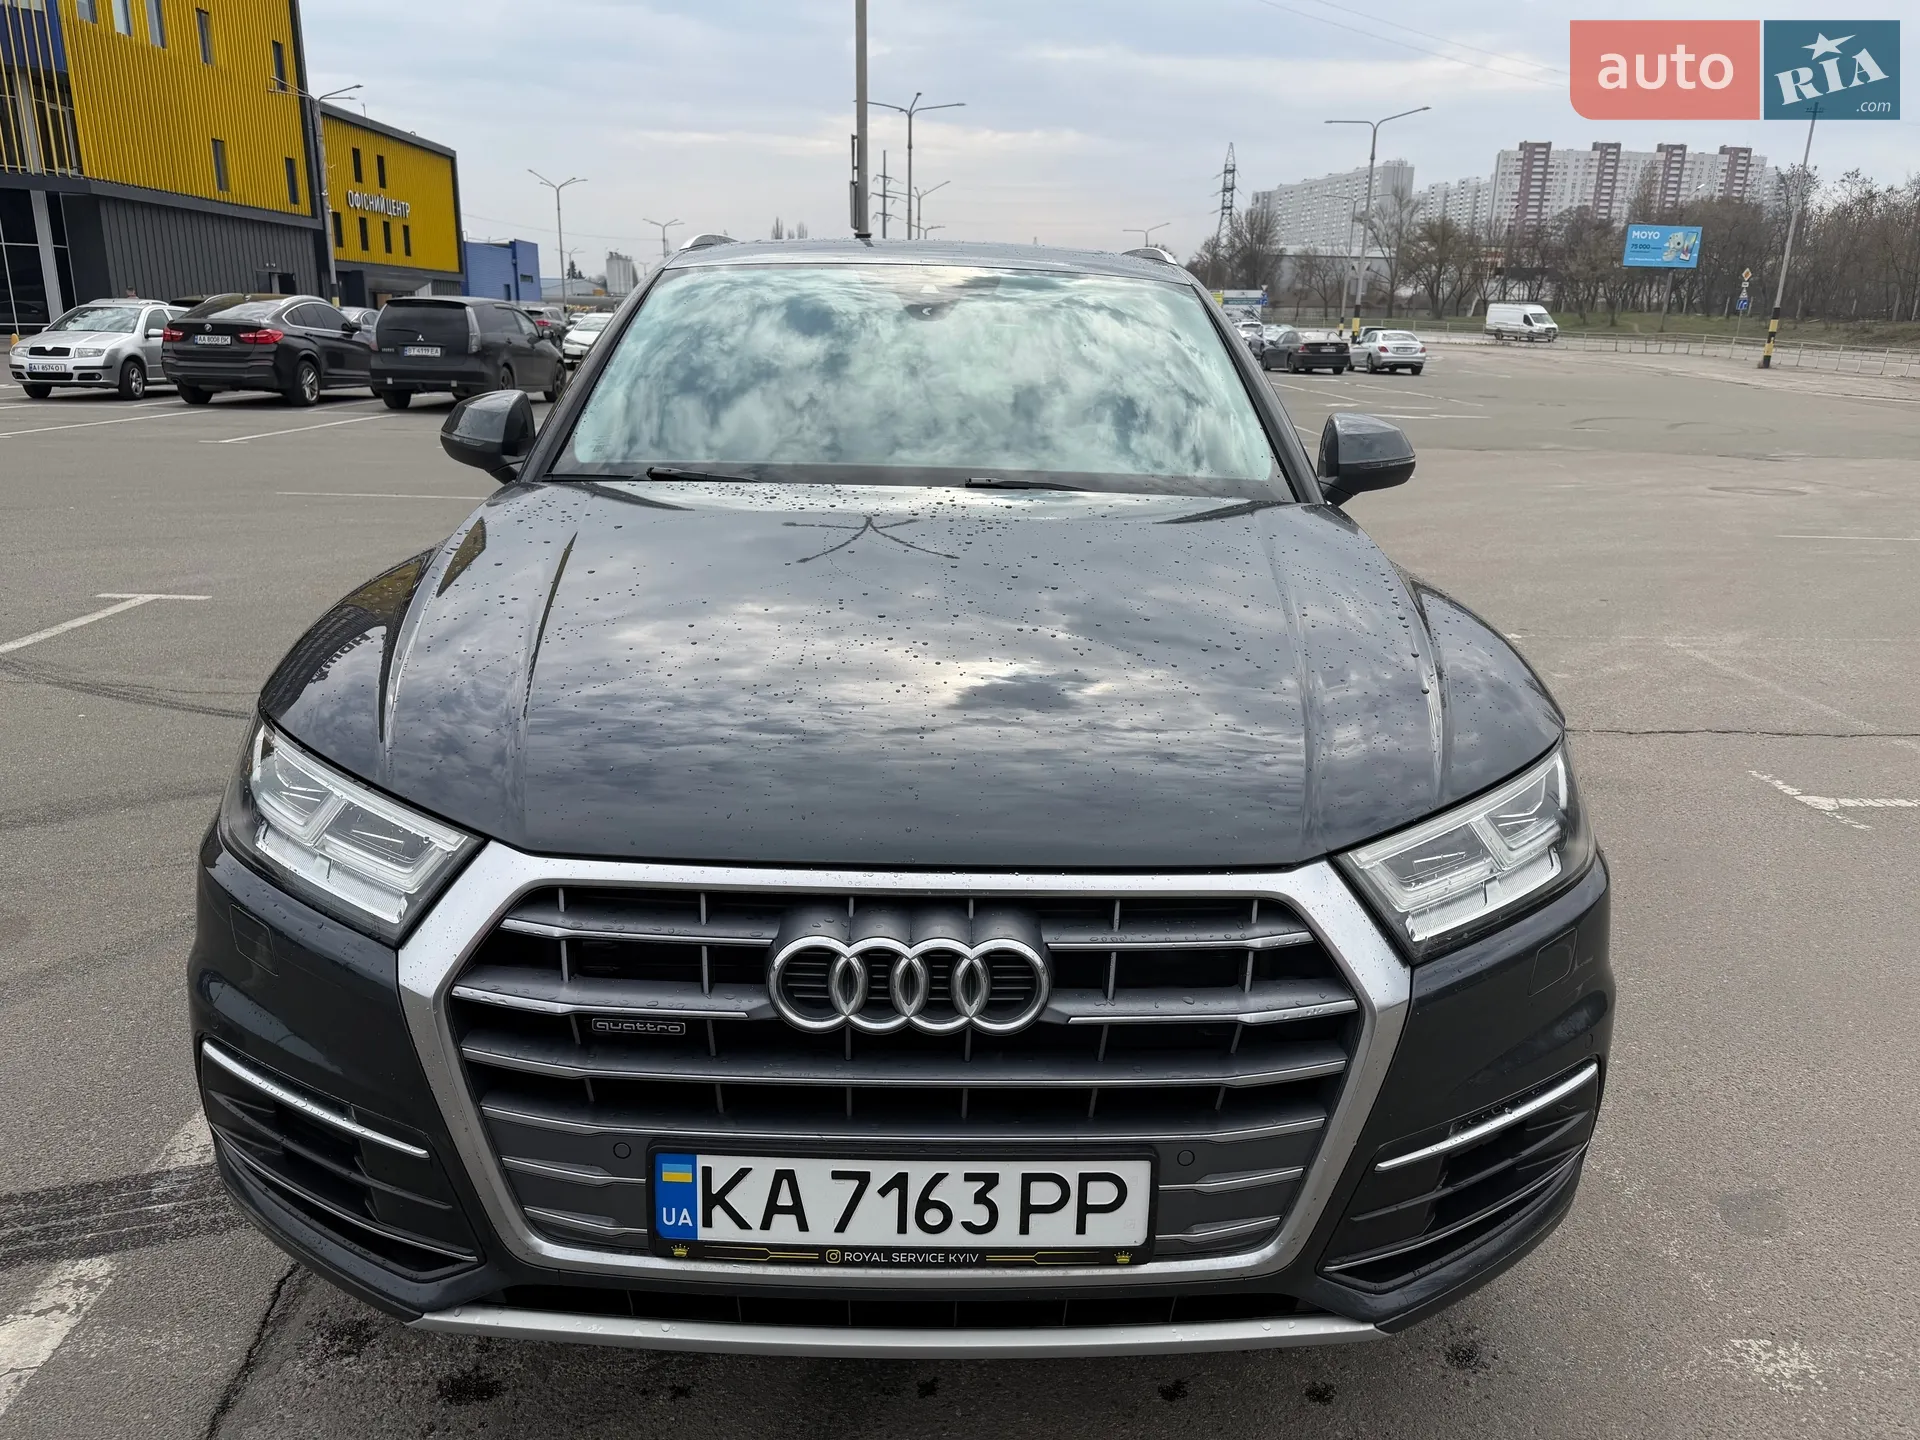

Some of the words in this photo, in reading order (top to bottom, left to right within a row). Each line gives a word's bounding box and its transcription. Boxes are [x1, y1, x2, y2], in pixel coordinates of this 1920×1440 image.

[347, 189, 386, 214] ОФІСНИЙ
[386, 197, 410, 218] ЦЕНТР
[1631, 230, 1660, 240] MOYO
[596, 1022, 681, 1032] quattro
[701, 1165, 809, 1232] KA
[831, 1170, 999, 1235] 7163
[1019, 1172, 1128, 1236] PP
[662, 1207, 693, 1227] UA
[844, 1251, 888, 1262] ROYAL
[891, 1252, 945, 1263] SERVICE
[948, 1253, 979, 1263] KYIV
